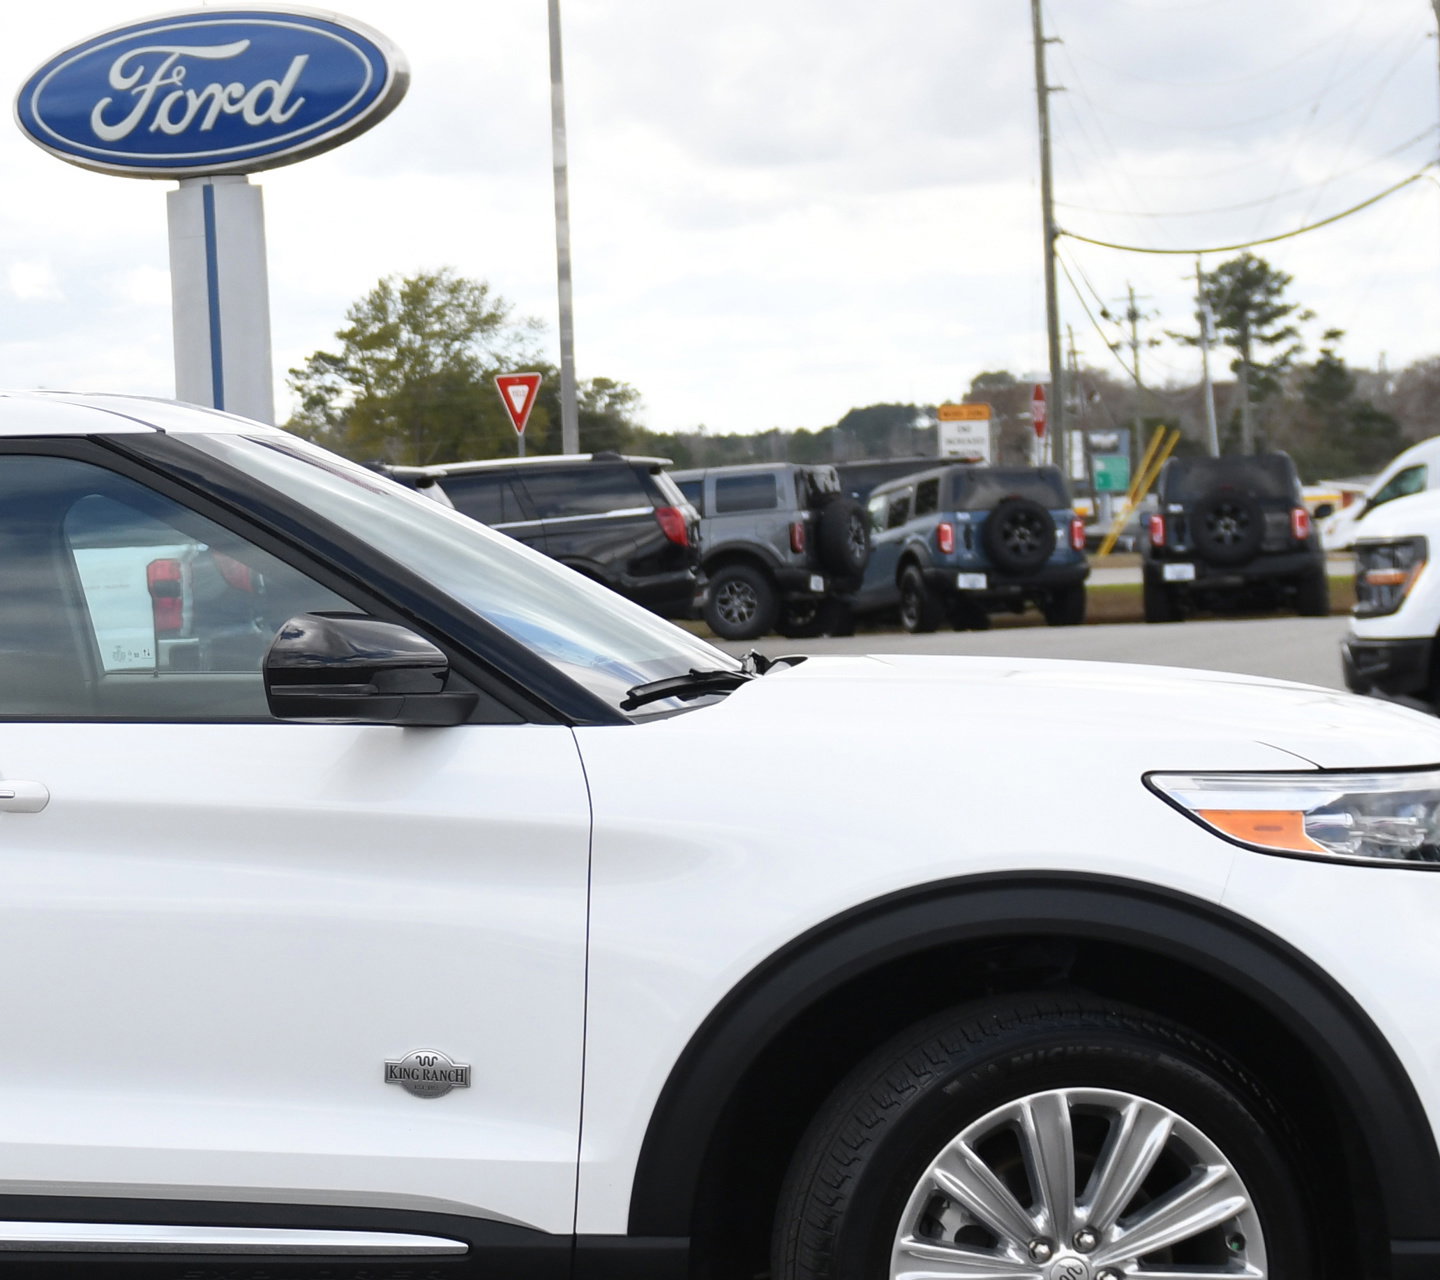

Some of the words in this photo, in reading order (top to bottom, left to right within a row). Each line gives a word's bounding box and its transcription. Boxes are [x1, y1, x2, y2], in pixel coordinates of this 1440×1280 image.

[90, 38, 309, 142] Ford
[389, 1065, 419, 1080] KING
[423, 1068, 465, 1083] RANCH
